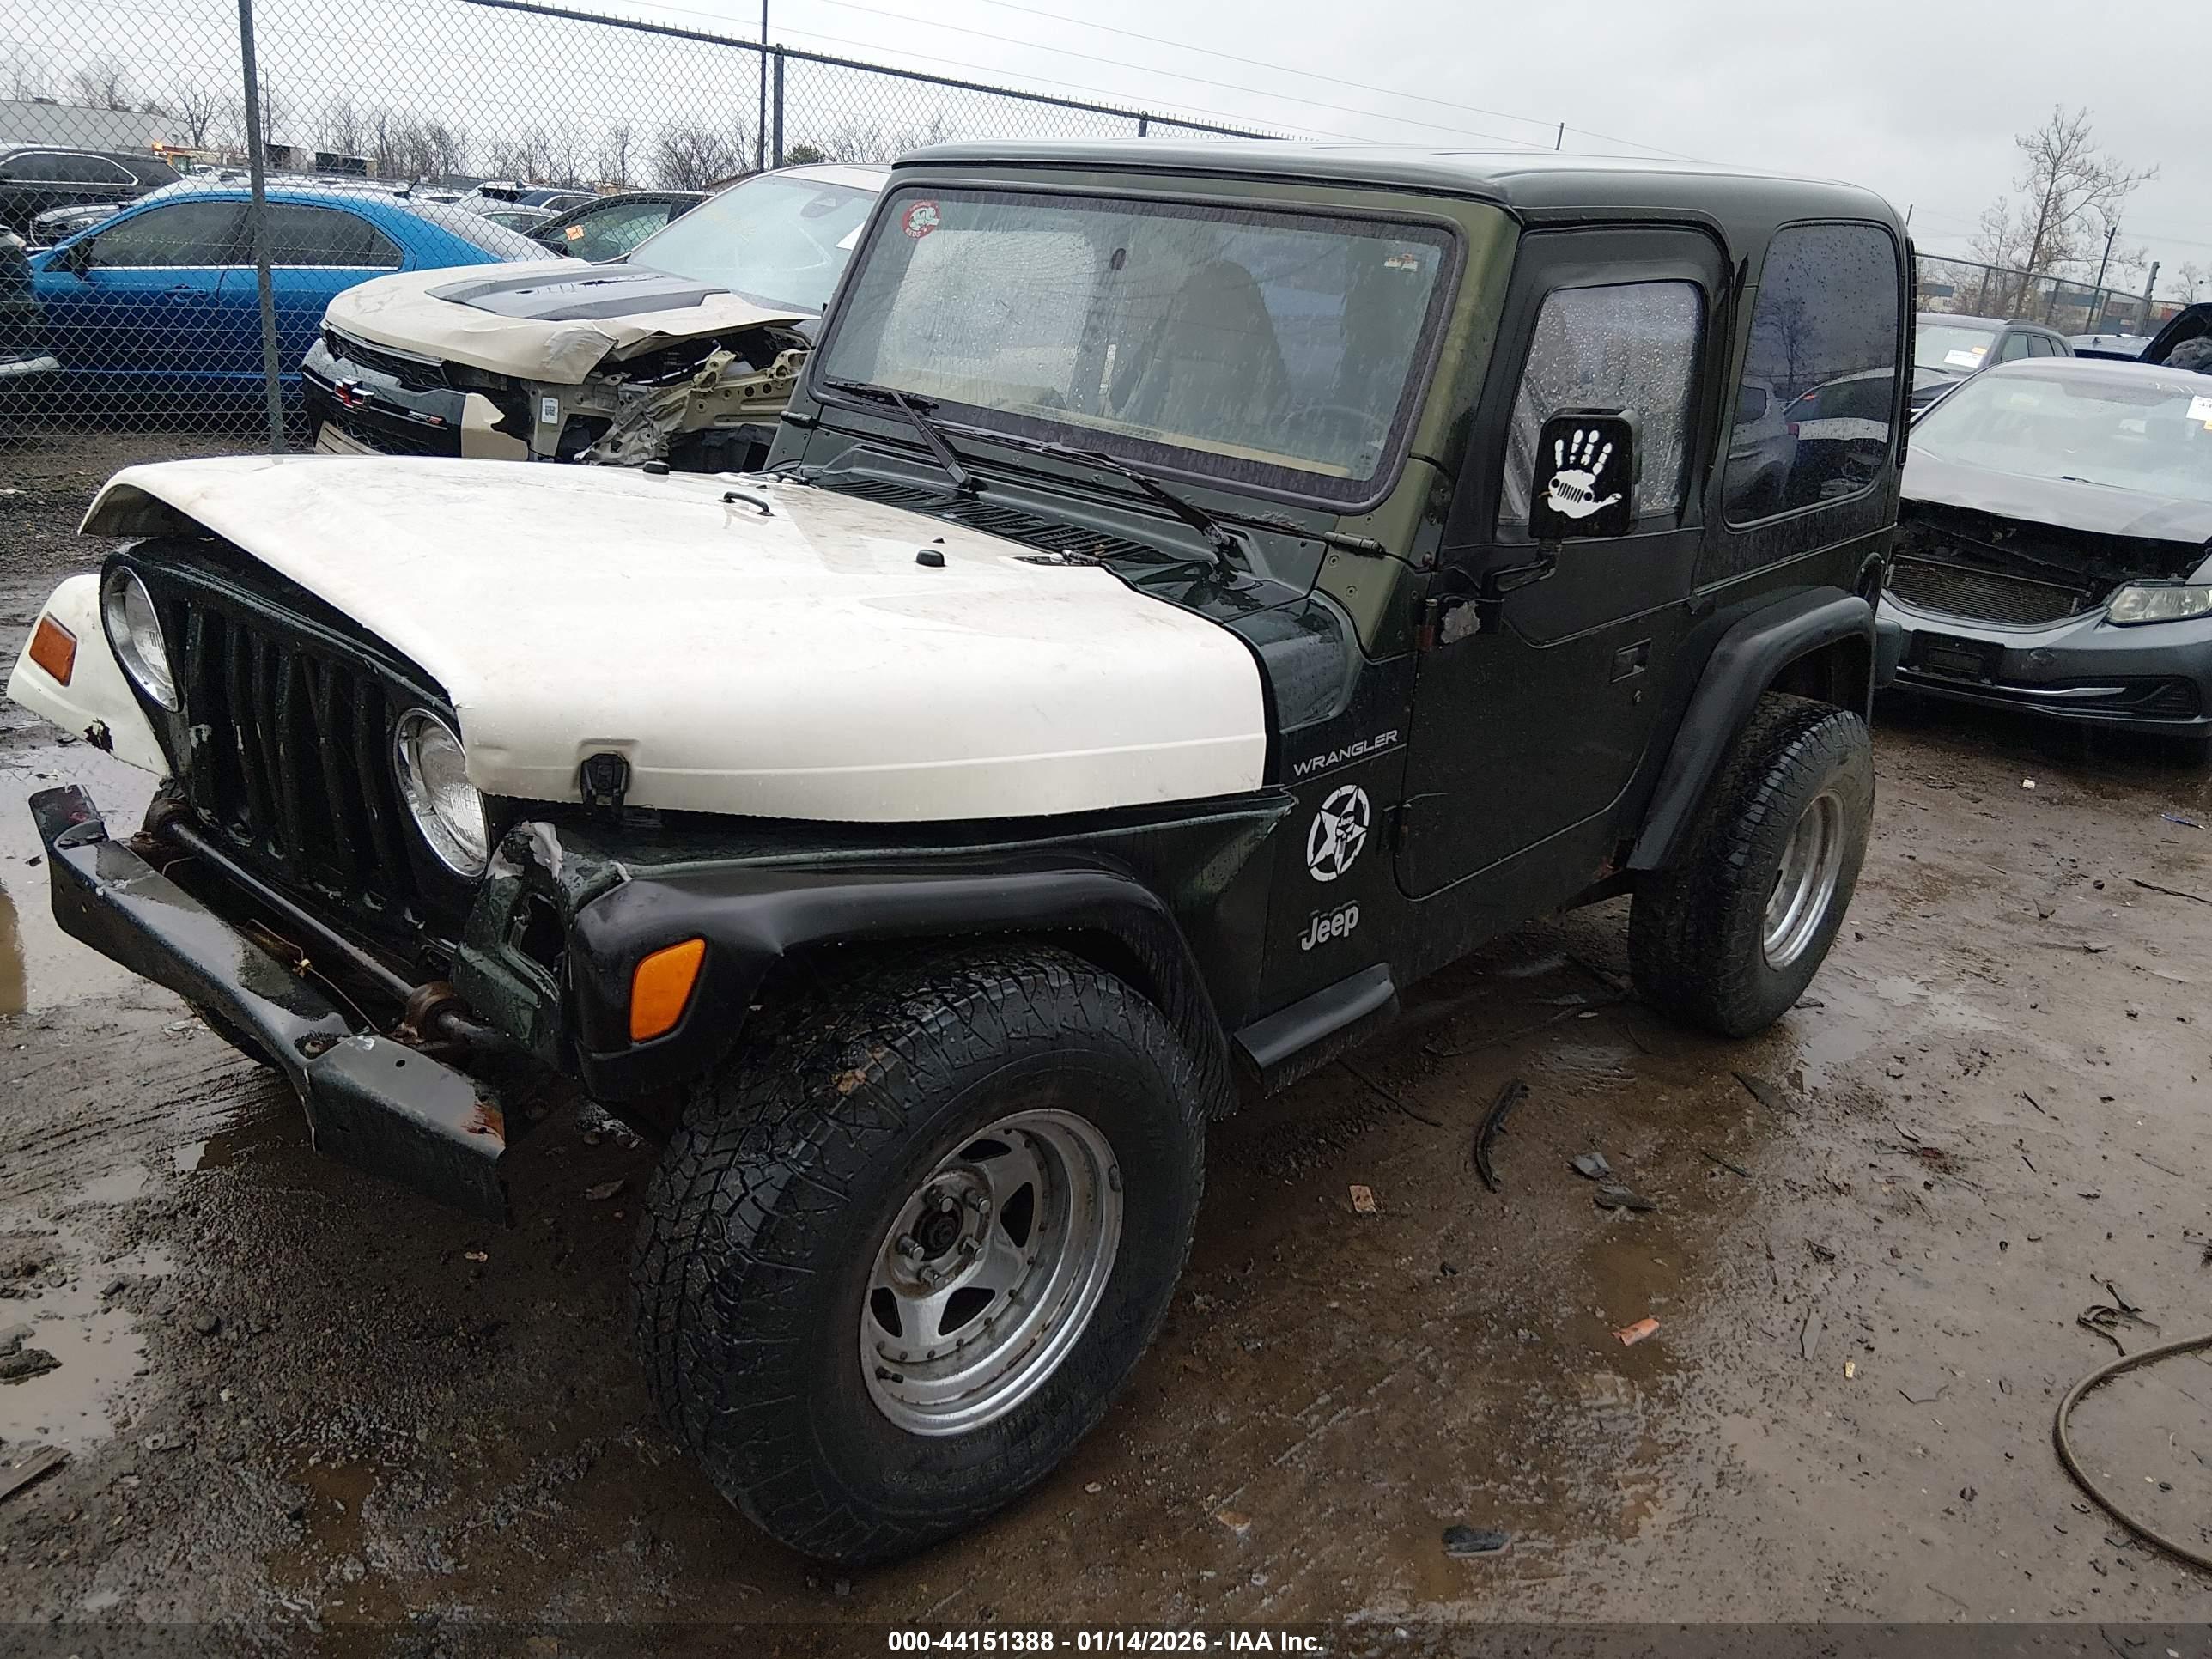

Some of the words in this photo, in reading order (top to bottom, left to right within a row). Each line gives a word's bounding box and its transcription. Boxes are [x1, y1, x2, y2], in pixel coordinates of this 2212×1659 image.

[1293, 729, 1398, 776] WRANGLER
[1338, 816, 1355, 828] Jeep
[1301, 905, 1359, 951] Jeep
